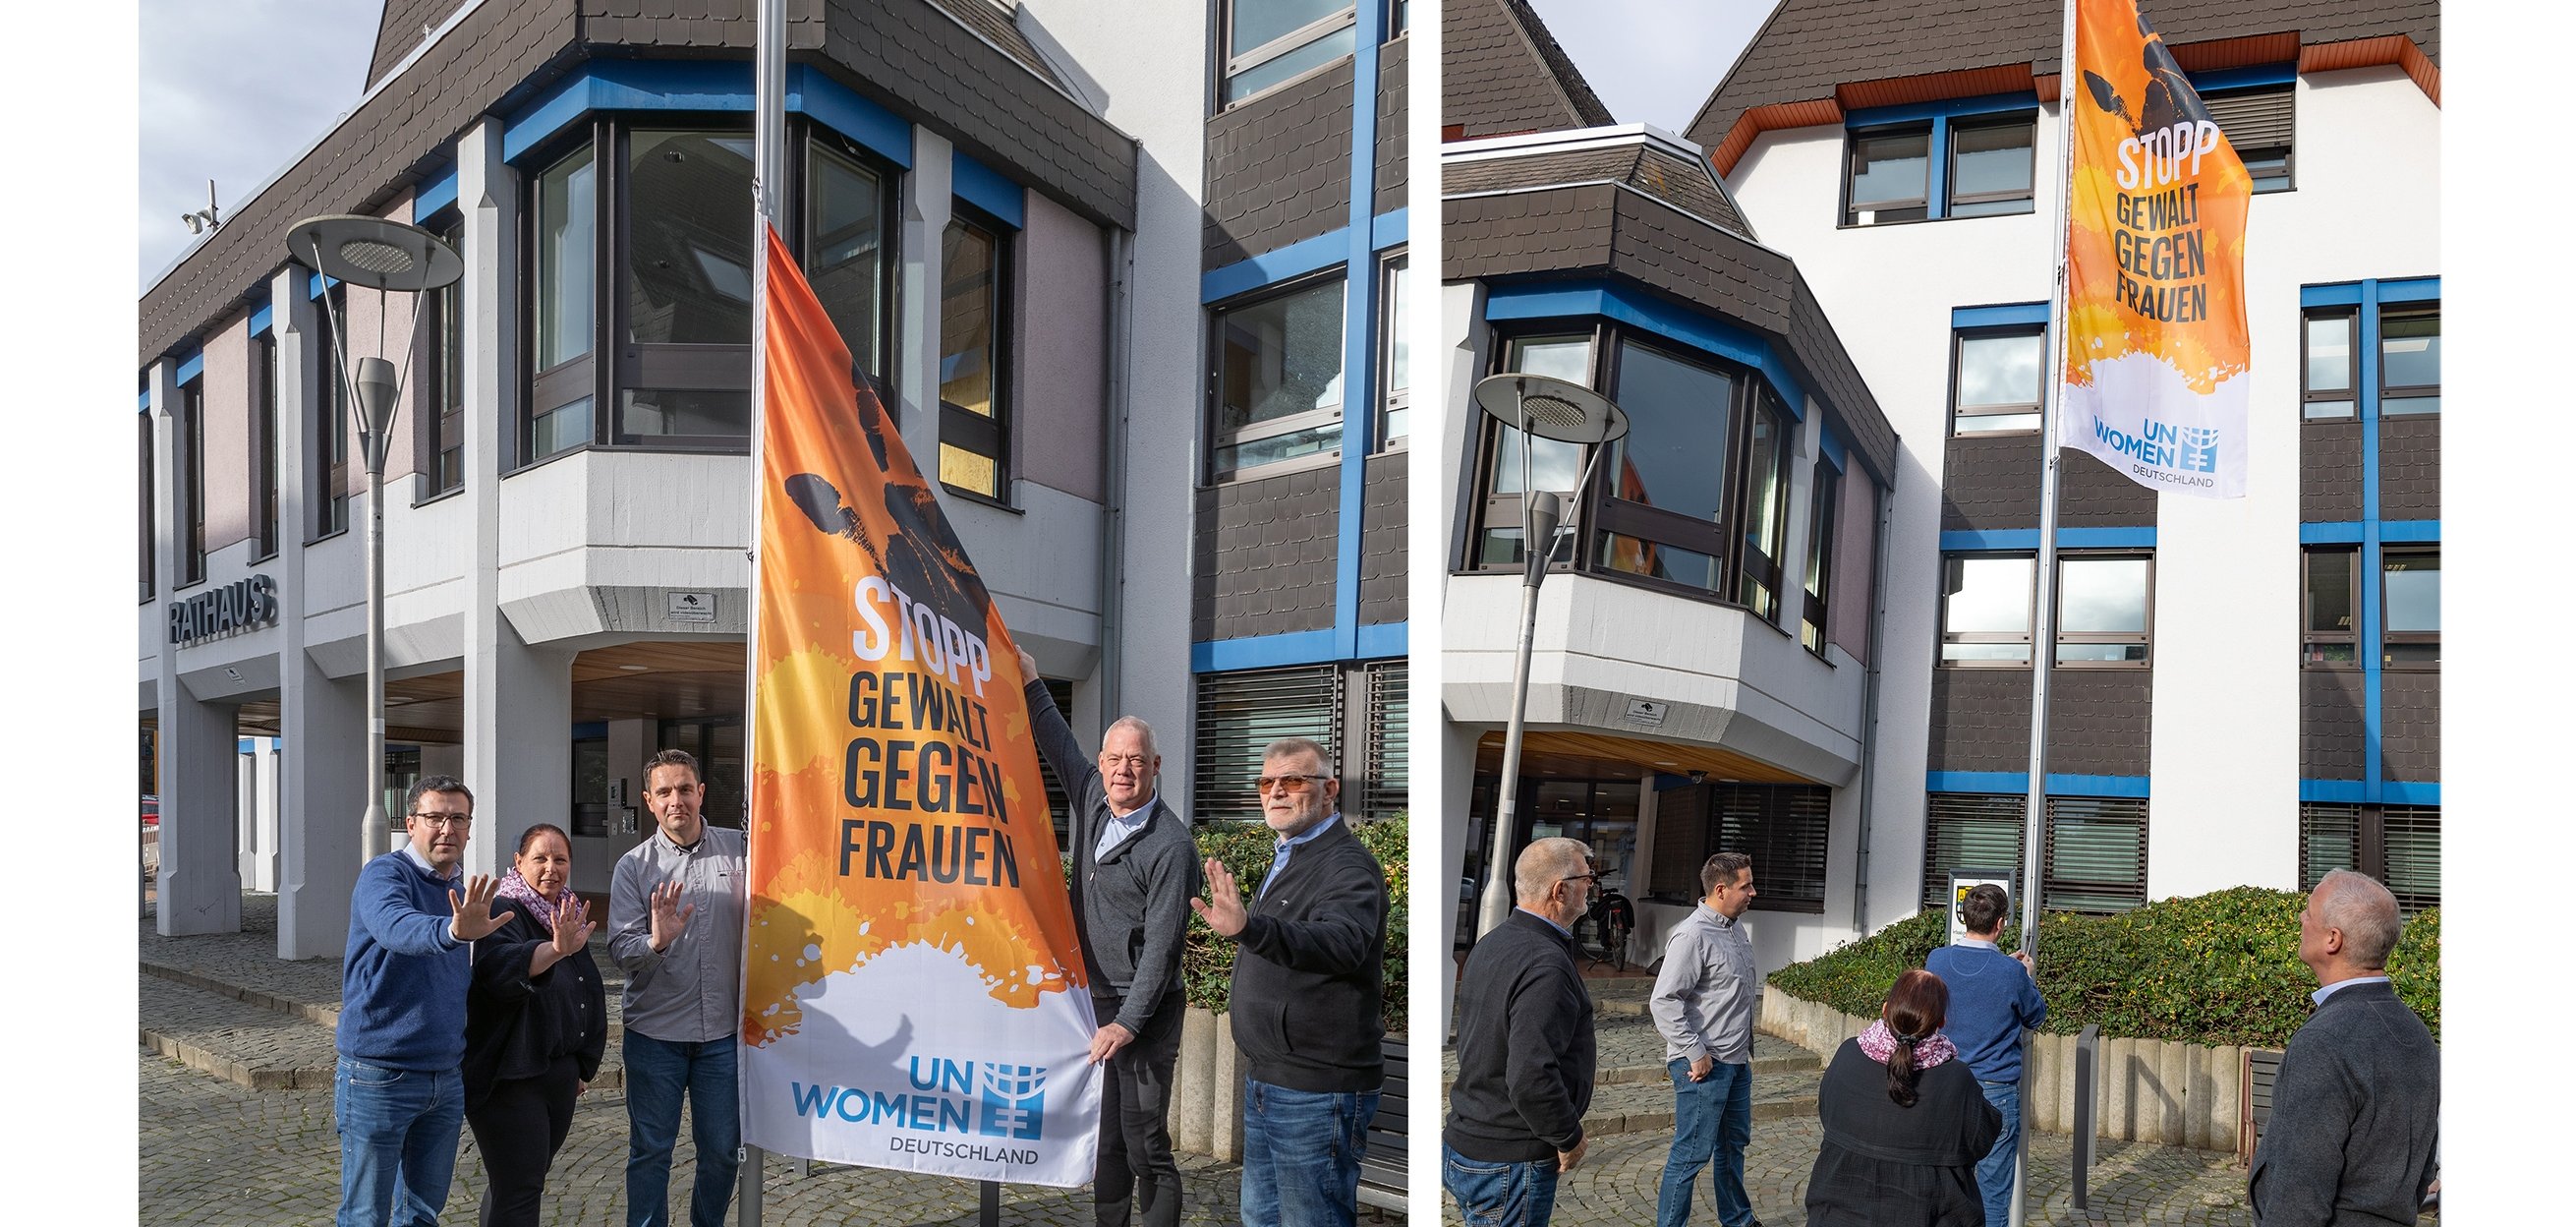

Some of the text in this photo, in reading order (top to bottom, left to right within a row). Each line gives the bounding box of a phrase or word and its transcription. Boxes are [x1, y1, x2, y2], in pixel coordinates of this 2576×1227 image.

[2116, 120, 2220, 190] STOPP
[2116, 183, 2199, 231] GEWALT
[2114, 228, 2205, 281] GEGEN
[2115, 268, 2206, 323] FRAUEN
[2093, 414, 2175, 468] WOMEN
[2143, 418, 2177, 445] UN
[2133, 463, 2214, 488] DEUTSCHLAND
[168, 573, 271, 644] RATHAUS
[852, 575, 992, 698] STOPP
[847, 671, 992, 752] GEWALT
[843, 736, 1008, 825] GEGEN
[838, 818, 1020, 889] FRAUEN
[909, 1055, 974, 1095] UN
[791, 1081, 973, 1135] WOMEN
[889, 1136, 1039, 1166] DEUTSCHLAND
